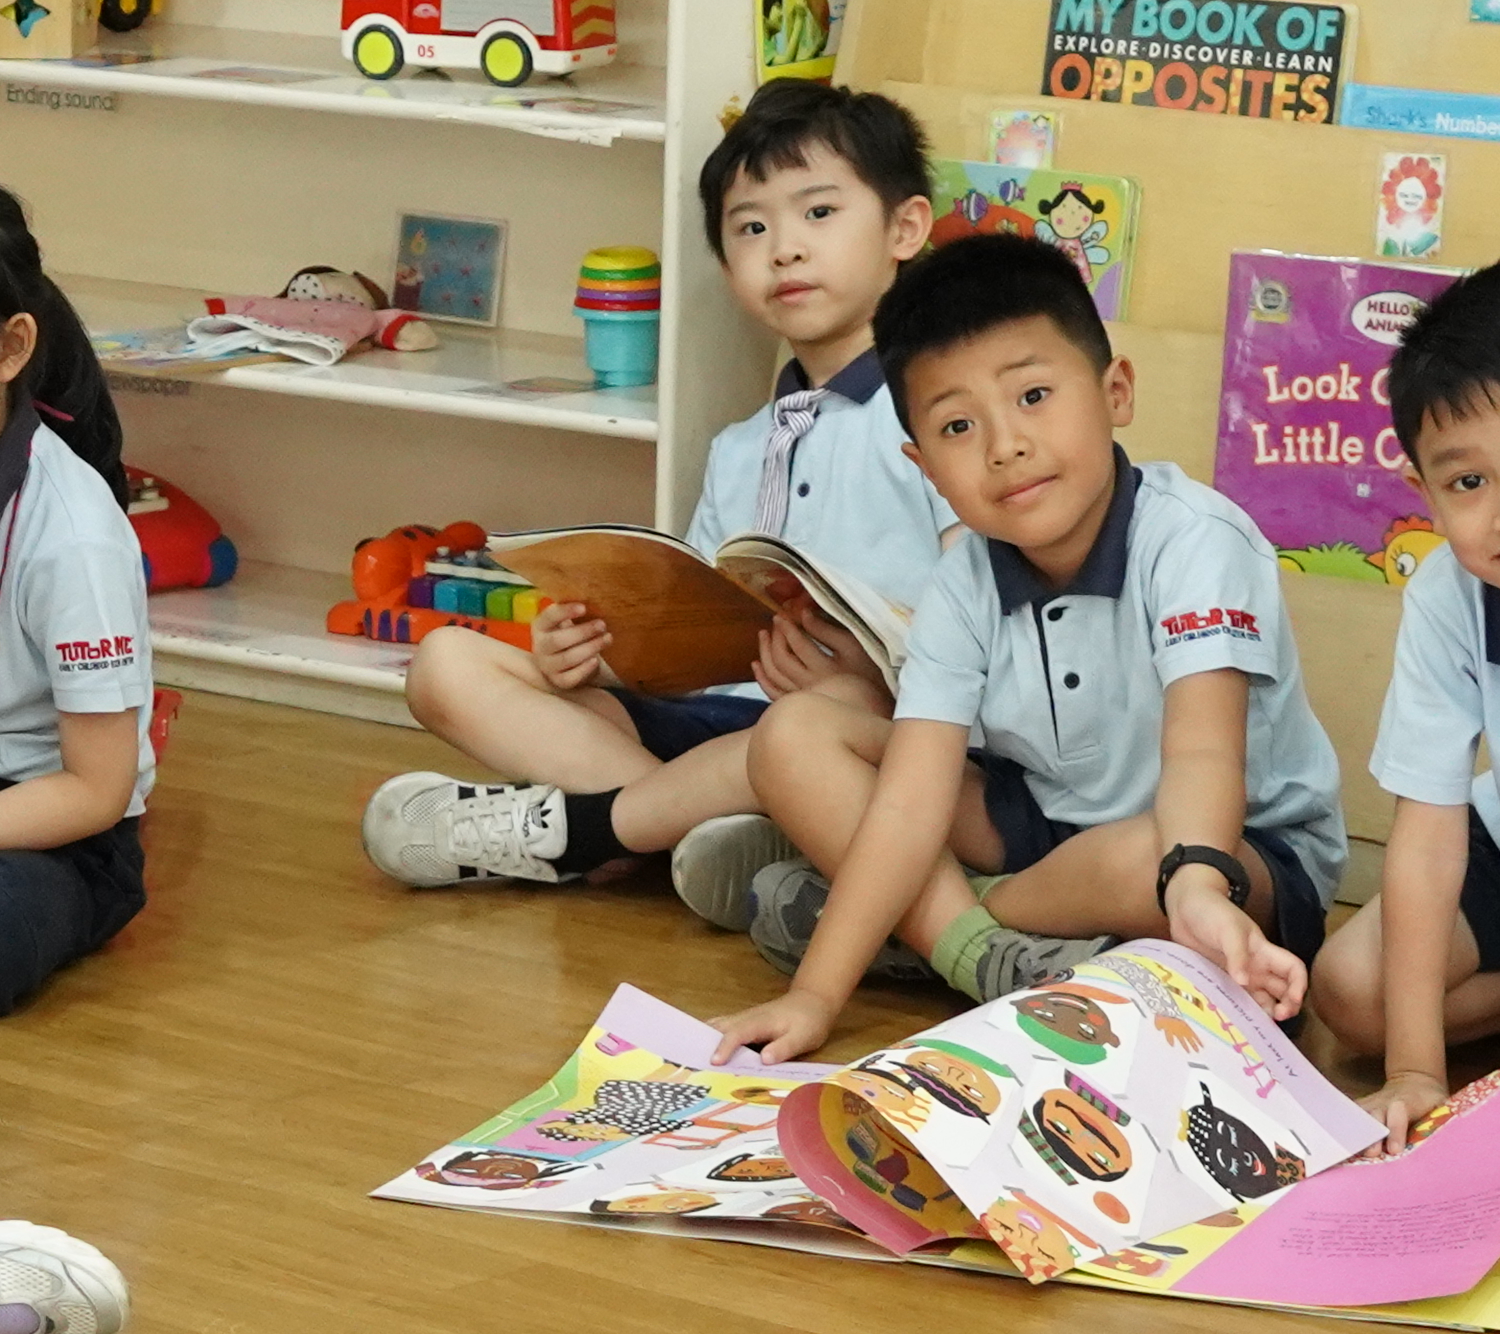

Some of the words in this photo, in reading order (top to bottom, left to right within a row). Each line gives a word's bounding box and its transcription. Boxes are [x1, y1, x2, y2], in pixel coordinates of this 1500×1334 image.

[1276, 5, 1340, 52] OF
[417, 44, 435, 58] 05
[1054, 34, 1139, 57] EXPLORE
[1148, 41, 1254, 67] DISCOVER
[1264, 51, 1333, 73] LEARN
[7, 83, 60, 110] Ending
[65, 91, 119, 111] sound
[1050, 53, 1331, 124] OPPOSITES
[1366, 299, 1410, 317] HELLO
[1262, 361, 1362, 403] Look
[1251, 421, 1365, 466] Little
